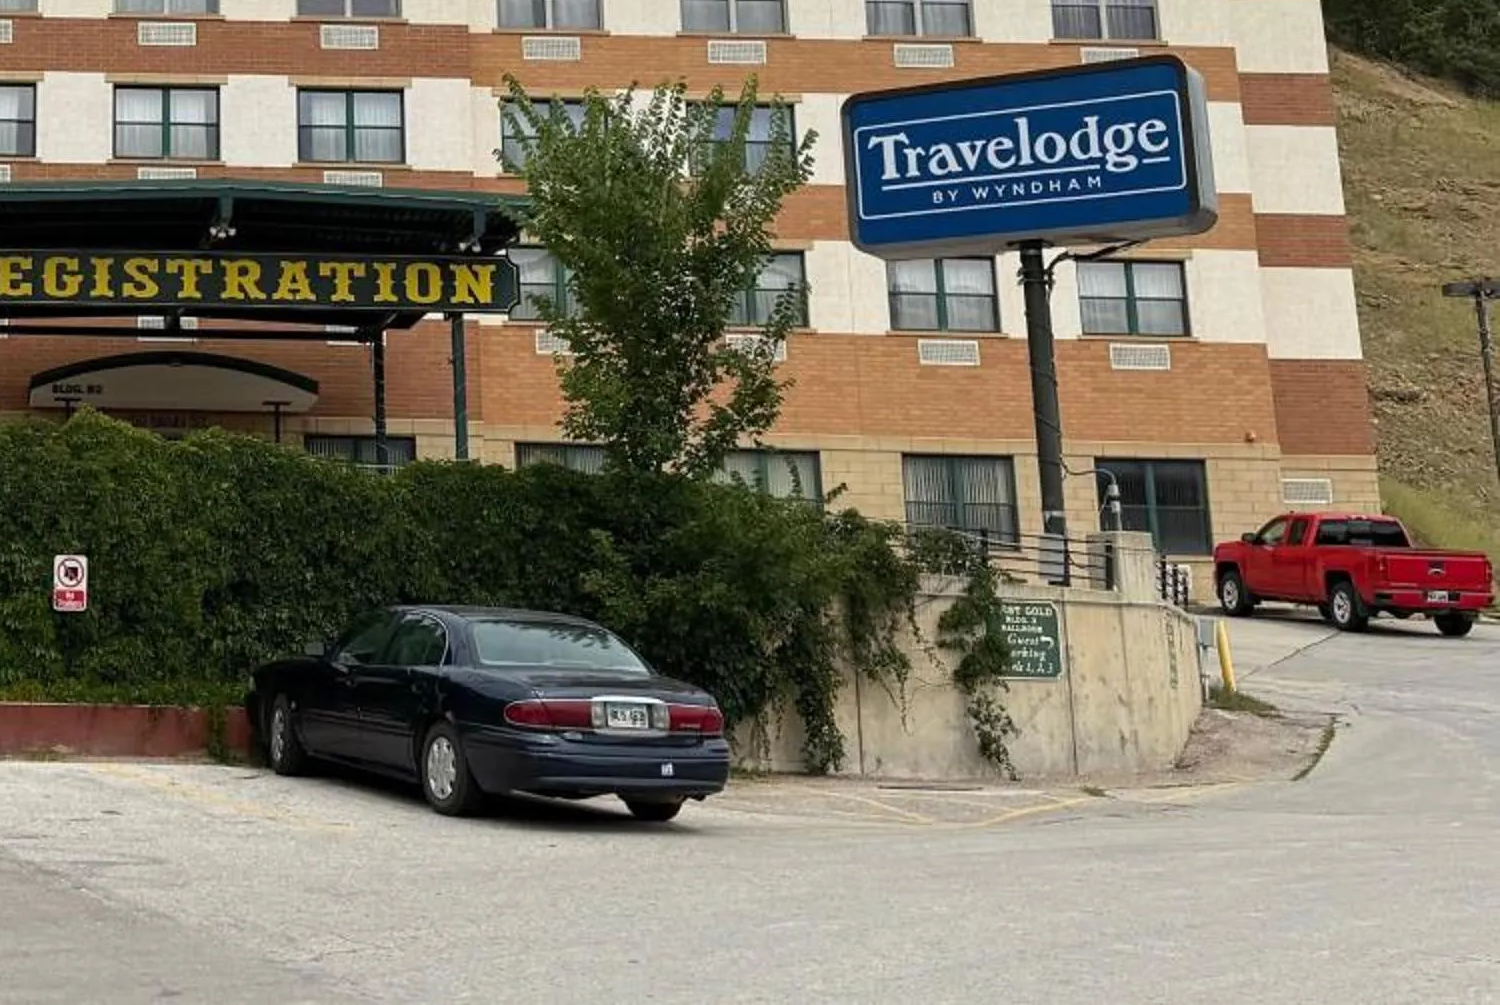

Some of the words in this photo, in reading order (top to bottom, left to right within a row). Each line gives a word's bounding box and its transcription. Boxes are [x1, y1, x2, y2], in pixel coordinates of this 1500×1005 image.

[868, 116, 1169, 179] Travelodge
[932, 189, 959, 204] BY
[973, 176, 1102, 200] WYNDHAM
[1025, 606, 1053, 616] GOLD
[1007, 633, 1040, 645] Guest
[1010, 646, 1047, 662] arking
